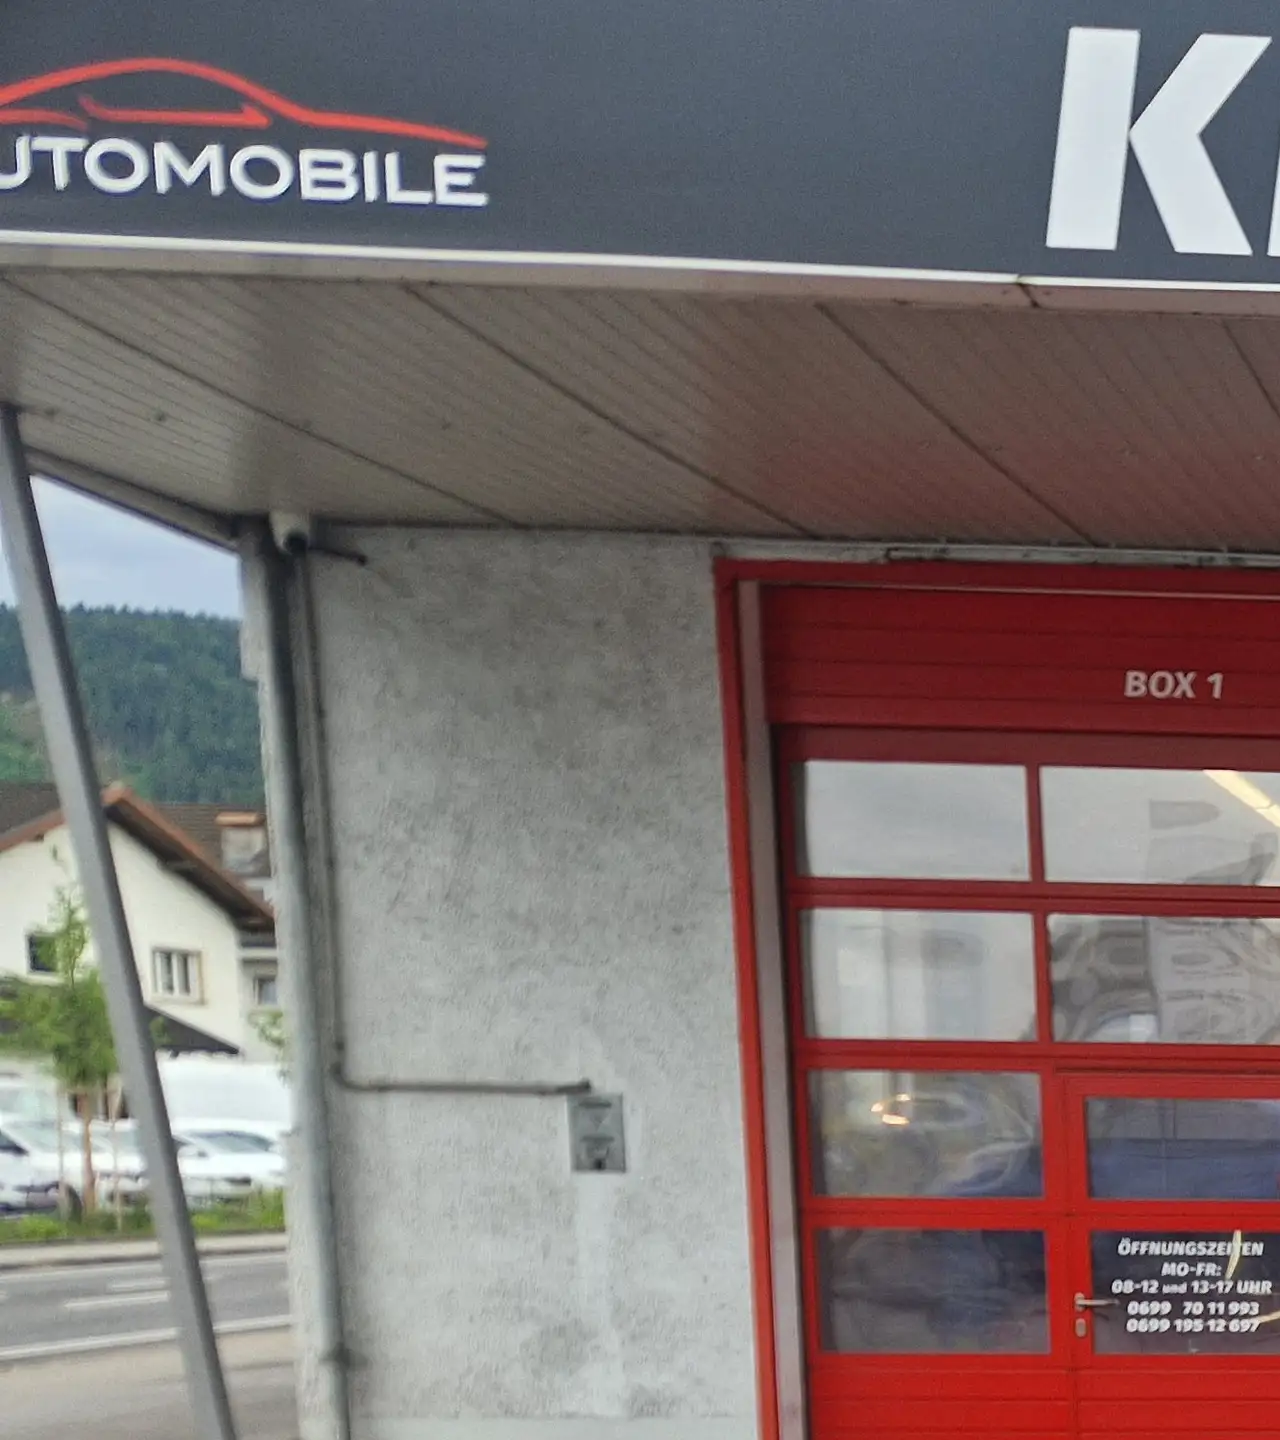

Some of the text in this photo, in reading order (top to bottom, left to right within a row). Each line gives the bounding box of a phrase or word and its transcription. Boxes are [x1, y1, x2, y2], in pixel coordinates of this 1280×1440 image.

[1124, 670, 1224, 699] BOX 1
[1117, 1237, 1264, 1256] ÖFFNUNGSZEIEN
[1161, 1262, 1221, 1277] MO-FR:
[1111, 1280, 1272, 1294] 08-12 und 13-17 UHR
[1127, 1301, 1260, 1316] 0699 70 11 993
[1126, 1318, 1171, 1333] 0699
[1207, 1318, 1226, 1332] 12
[1228, 1318, 1261, 1332] 697
